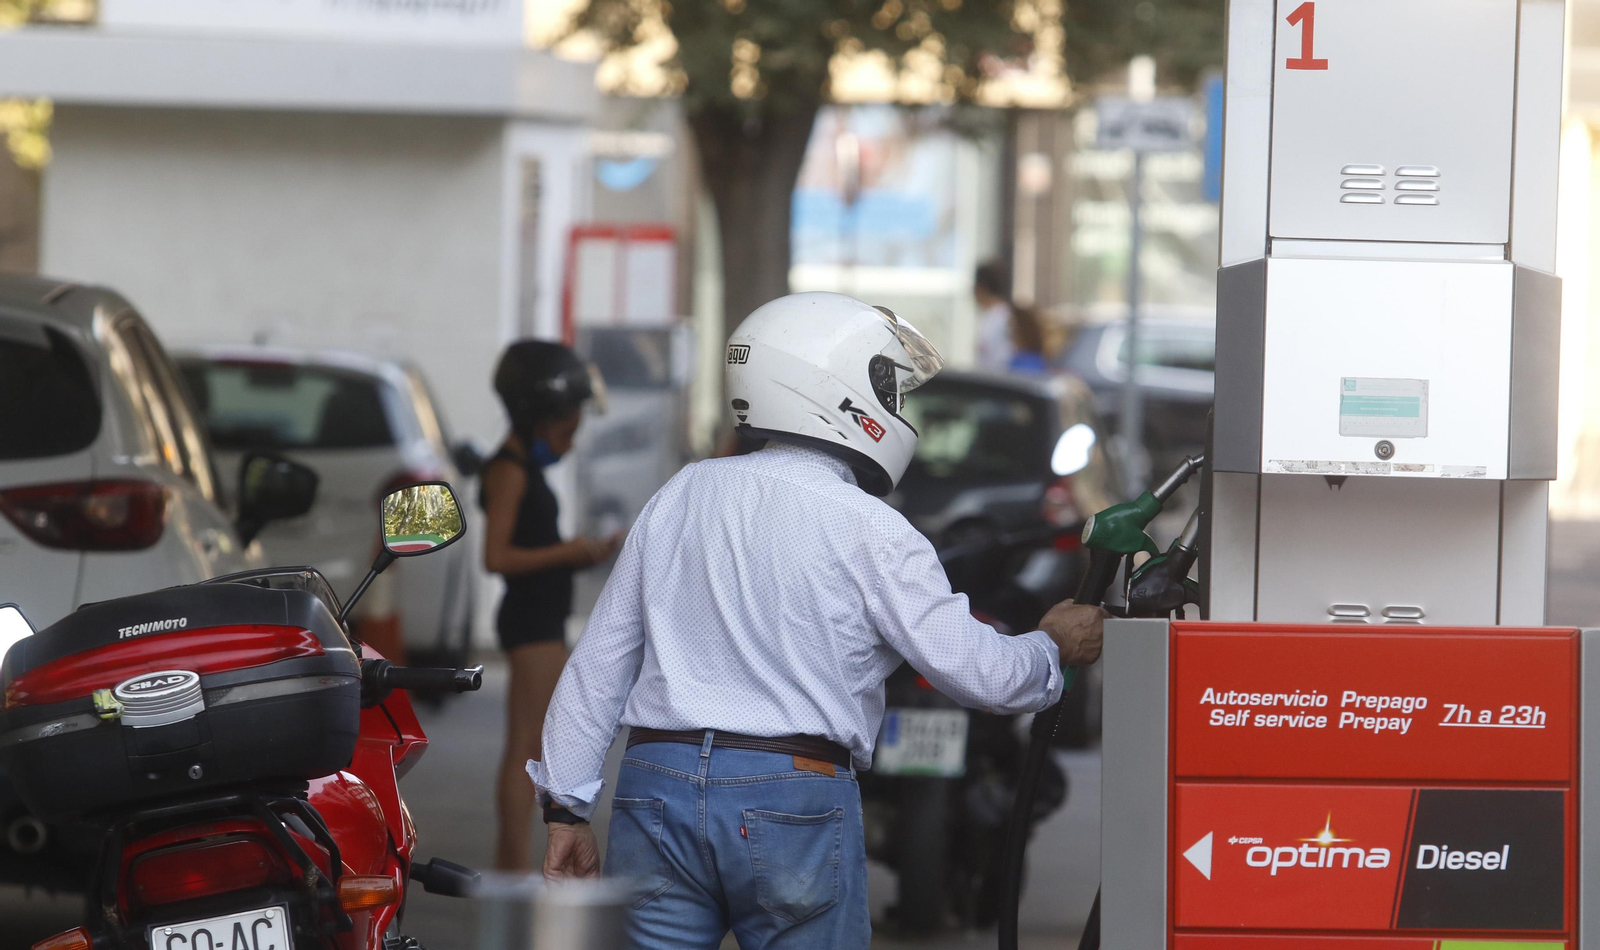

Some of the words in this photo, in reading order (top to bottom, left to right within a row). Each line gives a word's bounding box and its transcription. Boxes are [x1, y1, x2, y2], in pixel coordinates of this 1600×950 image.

[1285, 1, 1328, 70] 1
[118, 618, 187, 638] TECNIMOTO
[130, 675, 185, 691] SHAD
[1200, 687, 1328, 707] Autoservicio
[1341, 690, 1427, 713] Prepago
[1209, 708, 1250, 726] Self
[1254, 711, 1327, 728] service
[1339, 711, 1412, 735] Prepay
[1443, 704, 1471, 723] 7h
[1478, 709, 1492, 724] a
[1499, 705, 1546, 725] 23h
[1246, 843, 1391, 876] optima
[1416, 844, 1509, 870] Diesel
